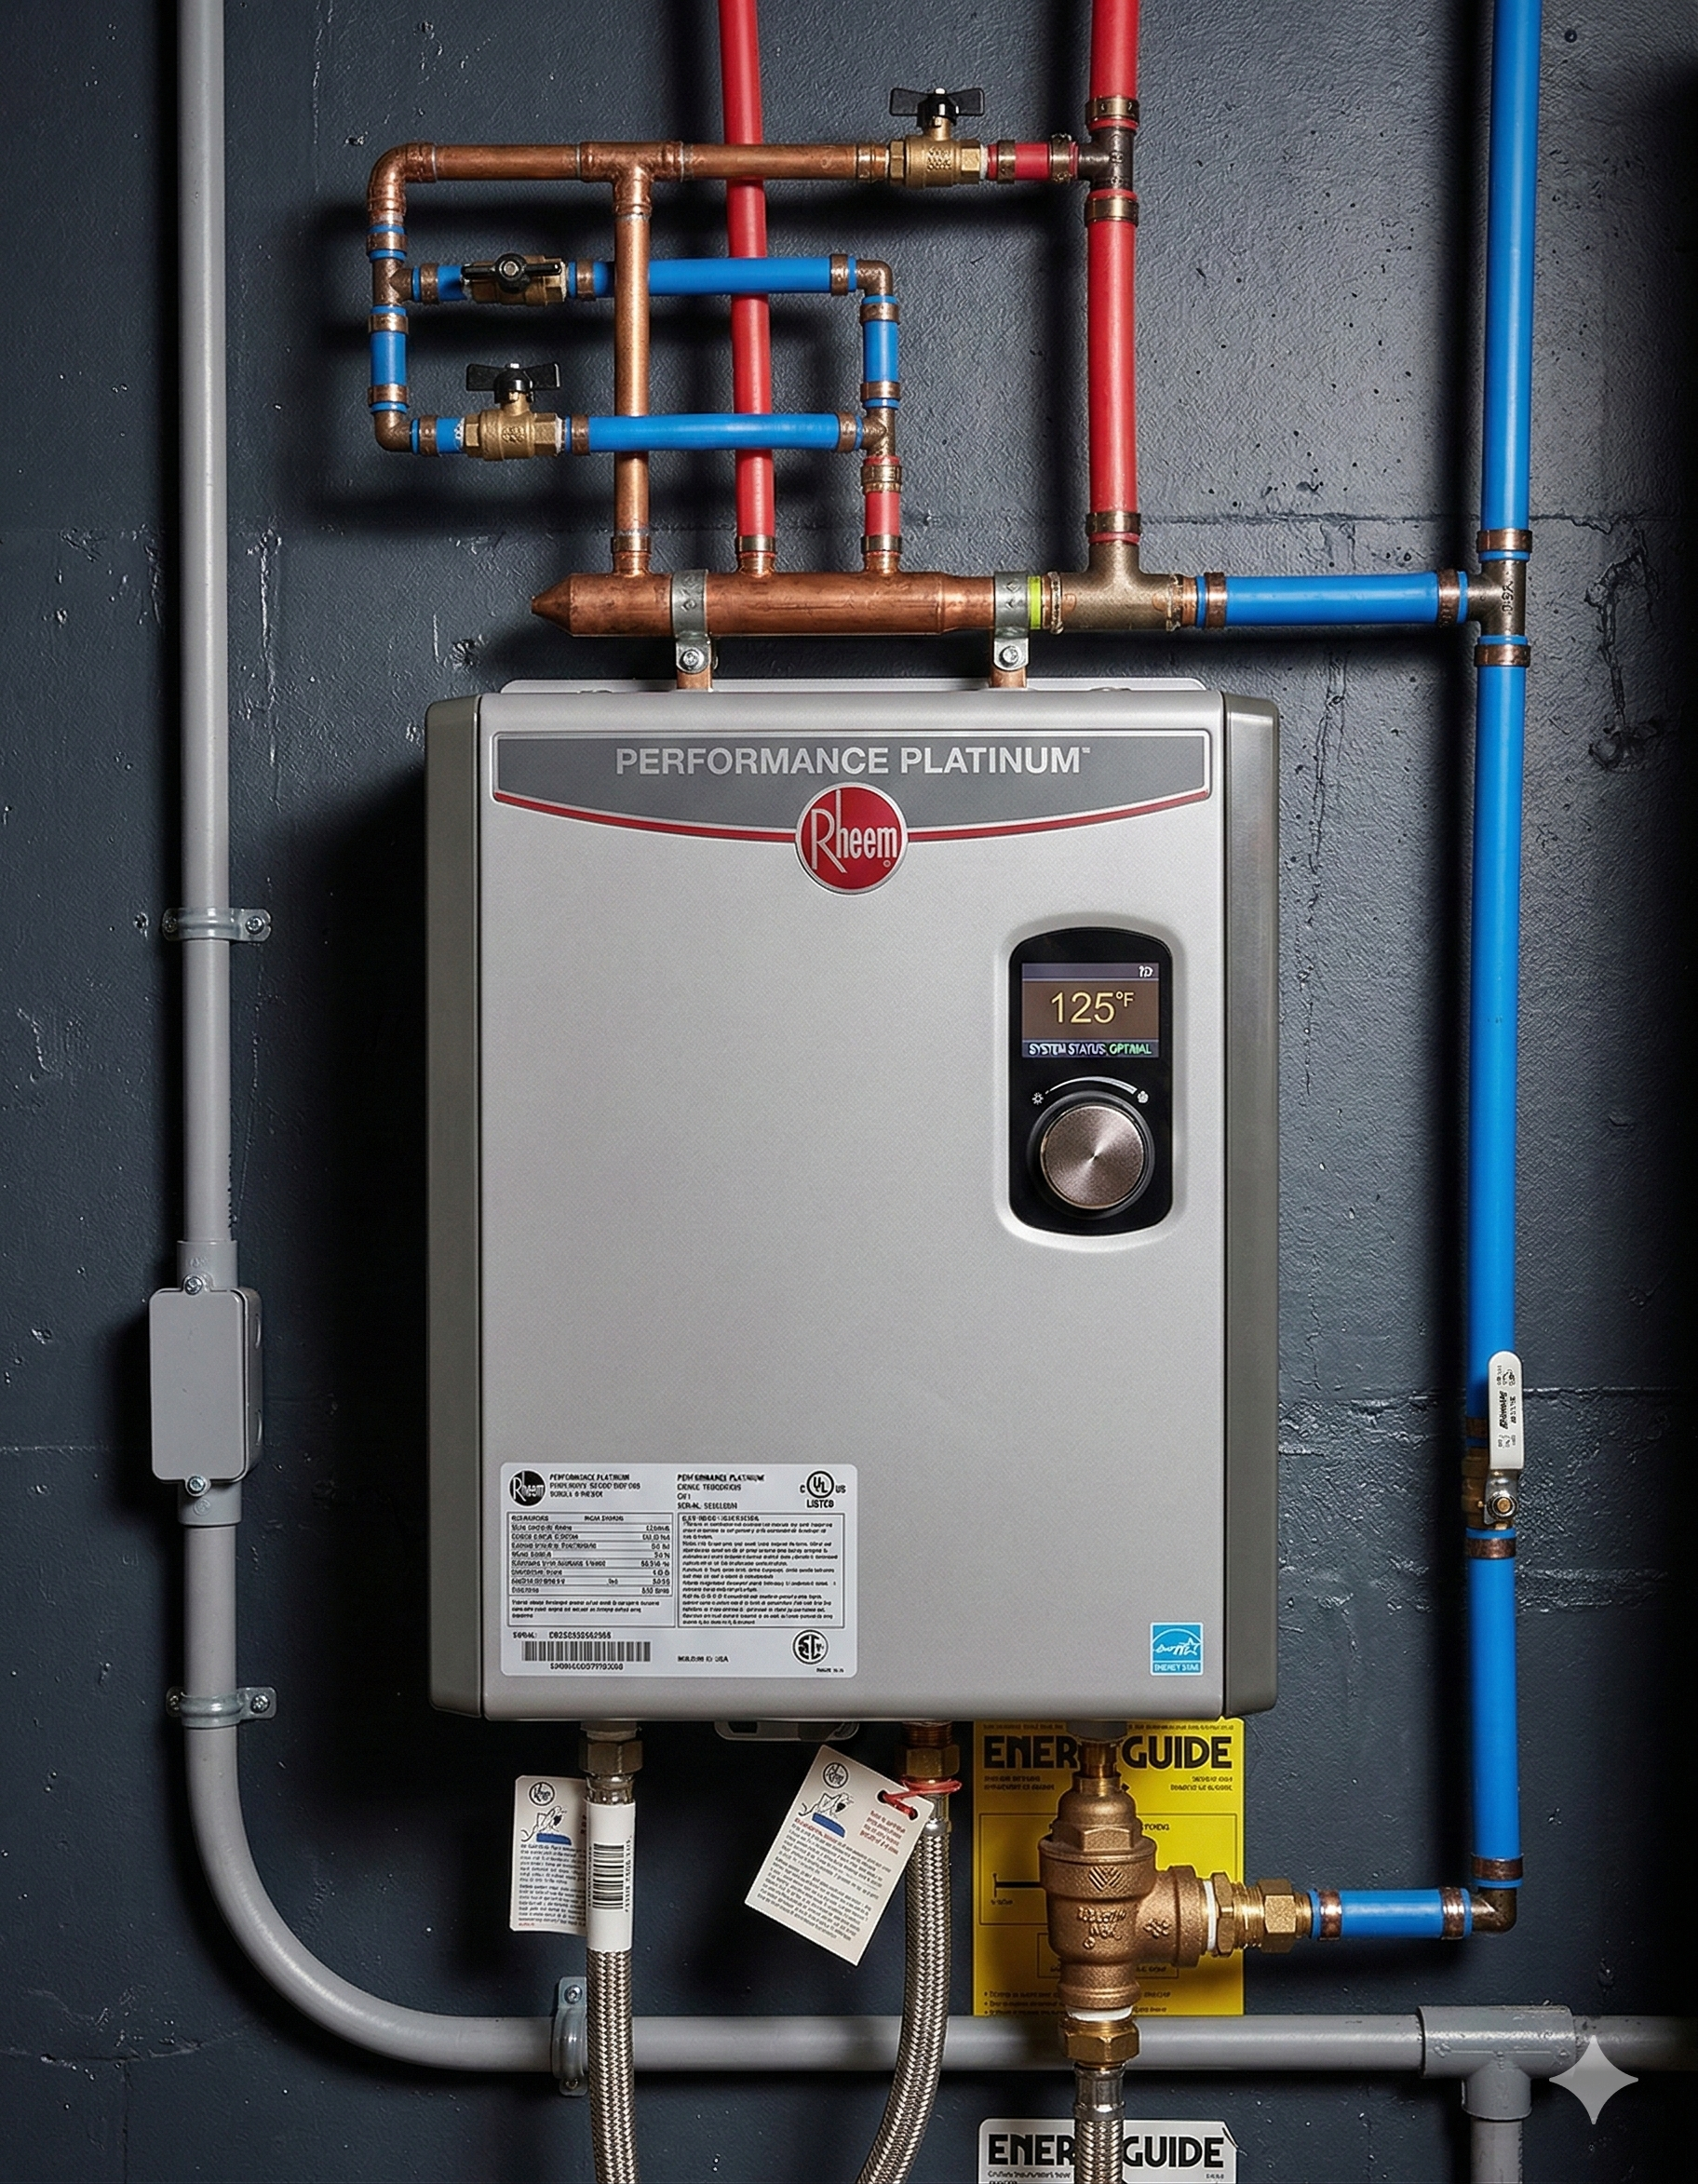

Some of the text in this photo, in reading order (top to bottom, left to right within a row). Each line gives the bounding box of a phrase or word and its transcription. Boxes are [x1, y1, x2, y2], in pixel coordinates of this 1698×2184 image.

[615, 747, 889, 775] PERFORMANCE
[810, 789, 898, 874] Rheem
[983, 1734, 1079, 1769] ENER
[988, 2134, 1075, 2166] ENER
